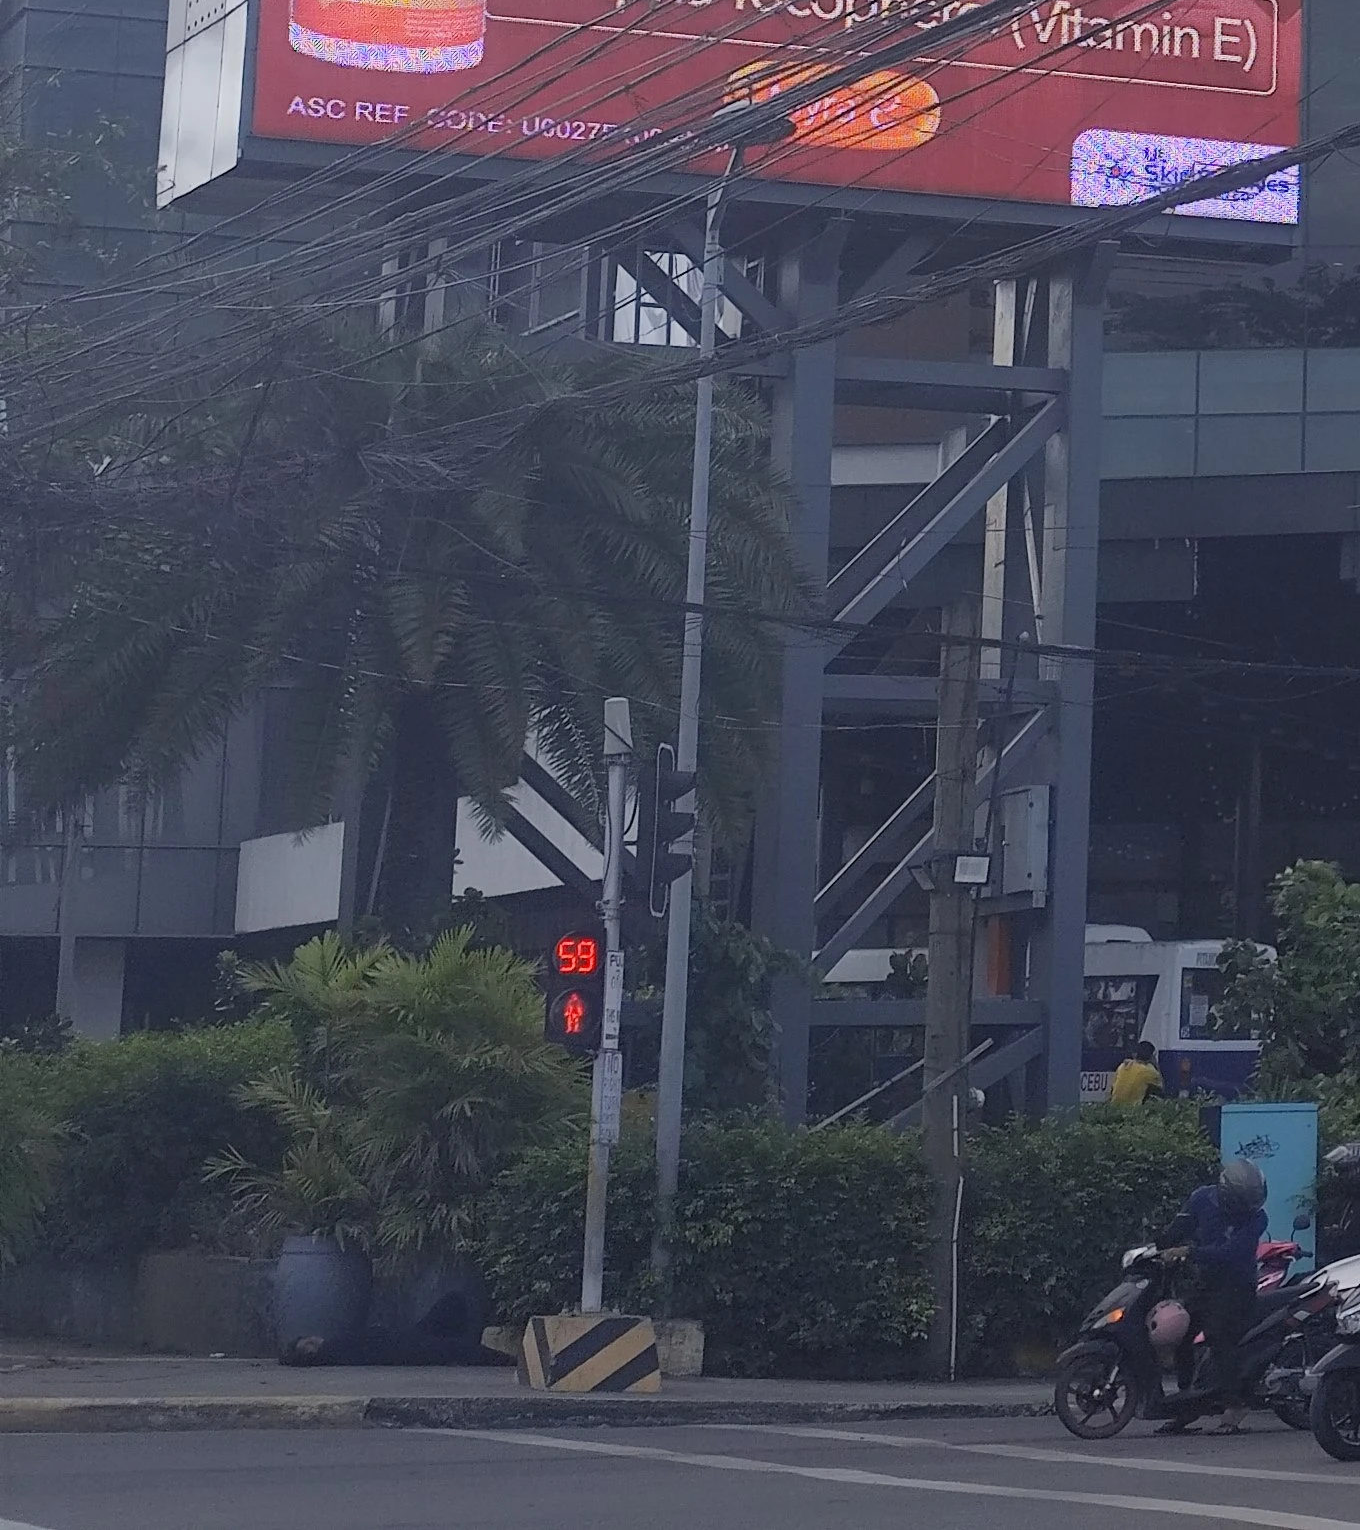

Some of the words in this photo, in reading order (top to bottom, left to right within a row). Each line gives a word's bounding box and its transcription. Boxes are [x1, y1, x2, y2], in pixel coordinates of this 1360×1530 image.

[1010, 0, 1200, 59] (Vitamin
[1213, 15, 1257, 73] E)
[287, 95, 346, 120] ASC
[557, 940, 597, 974] 59
[1081, 1073, 1108, 1091] CEBU
